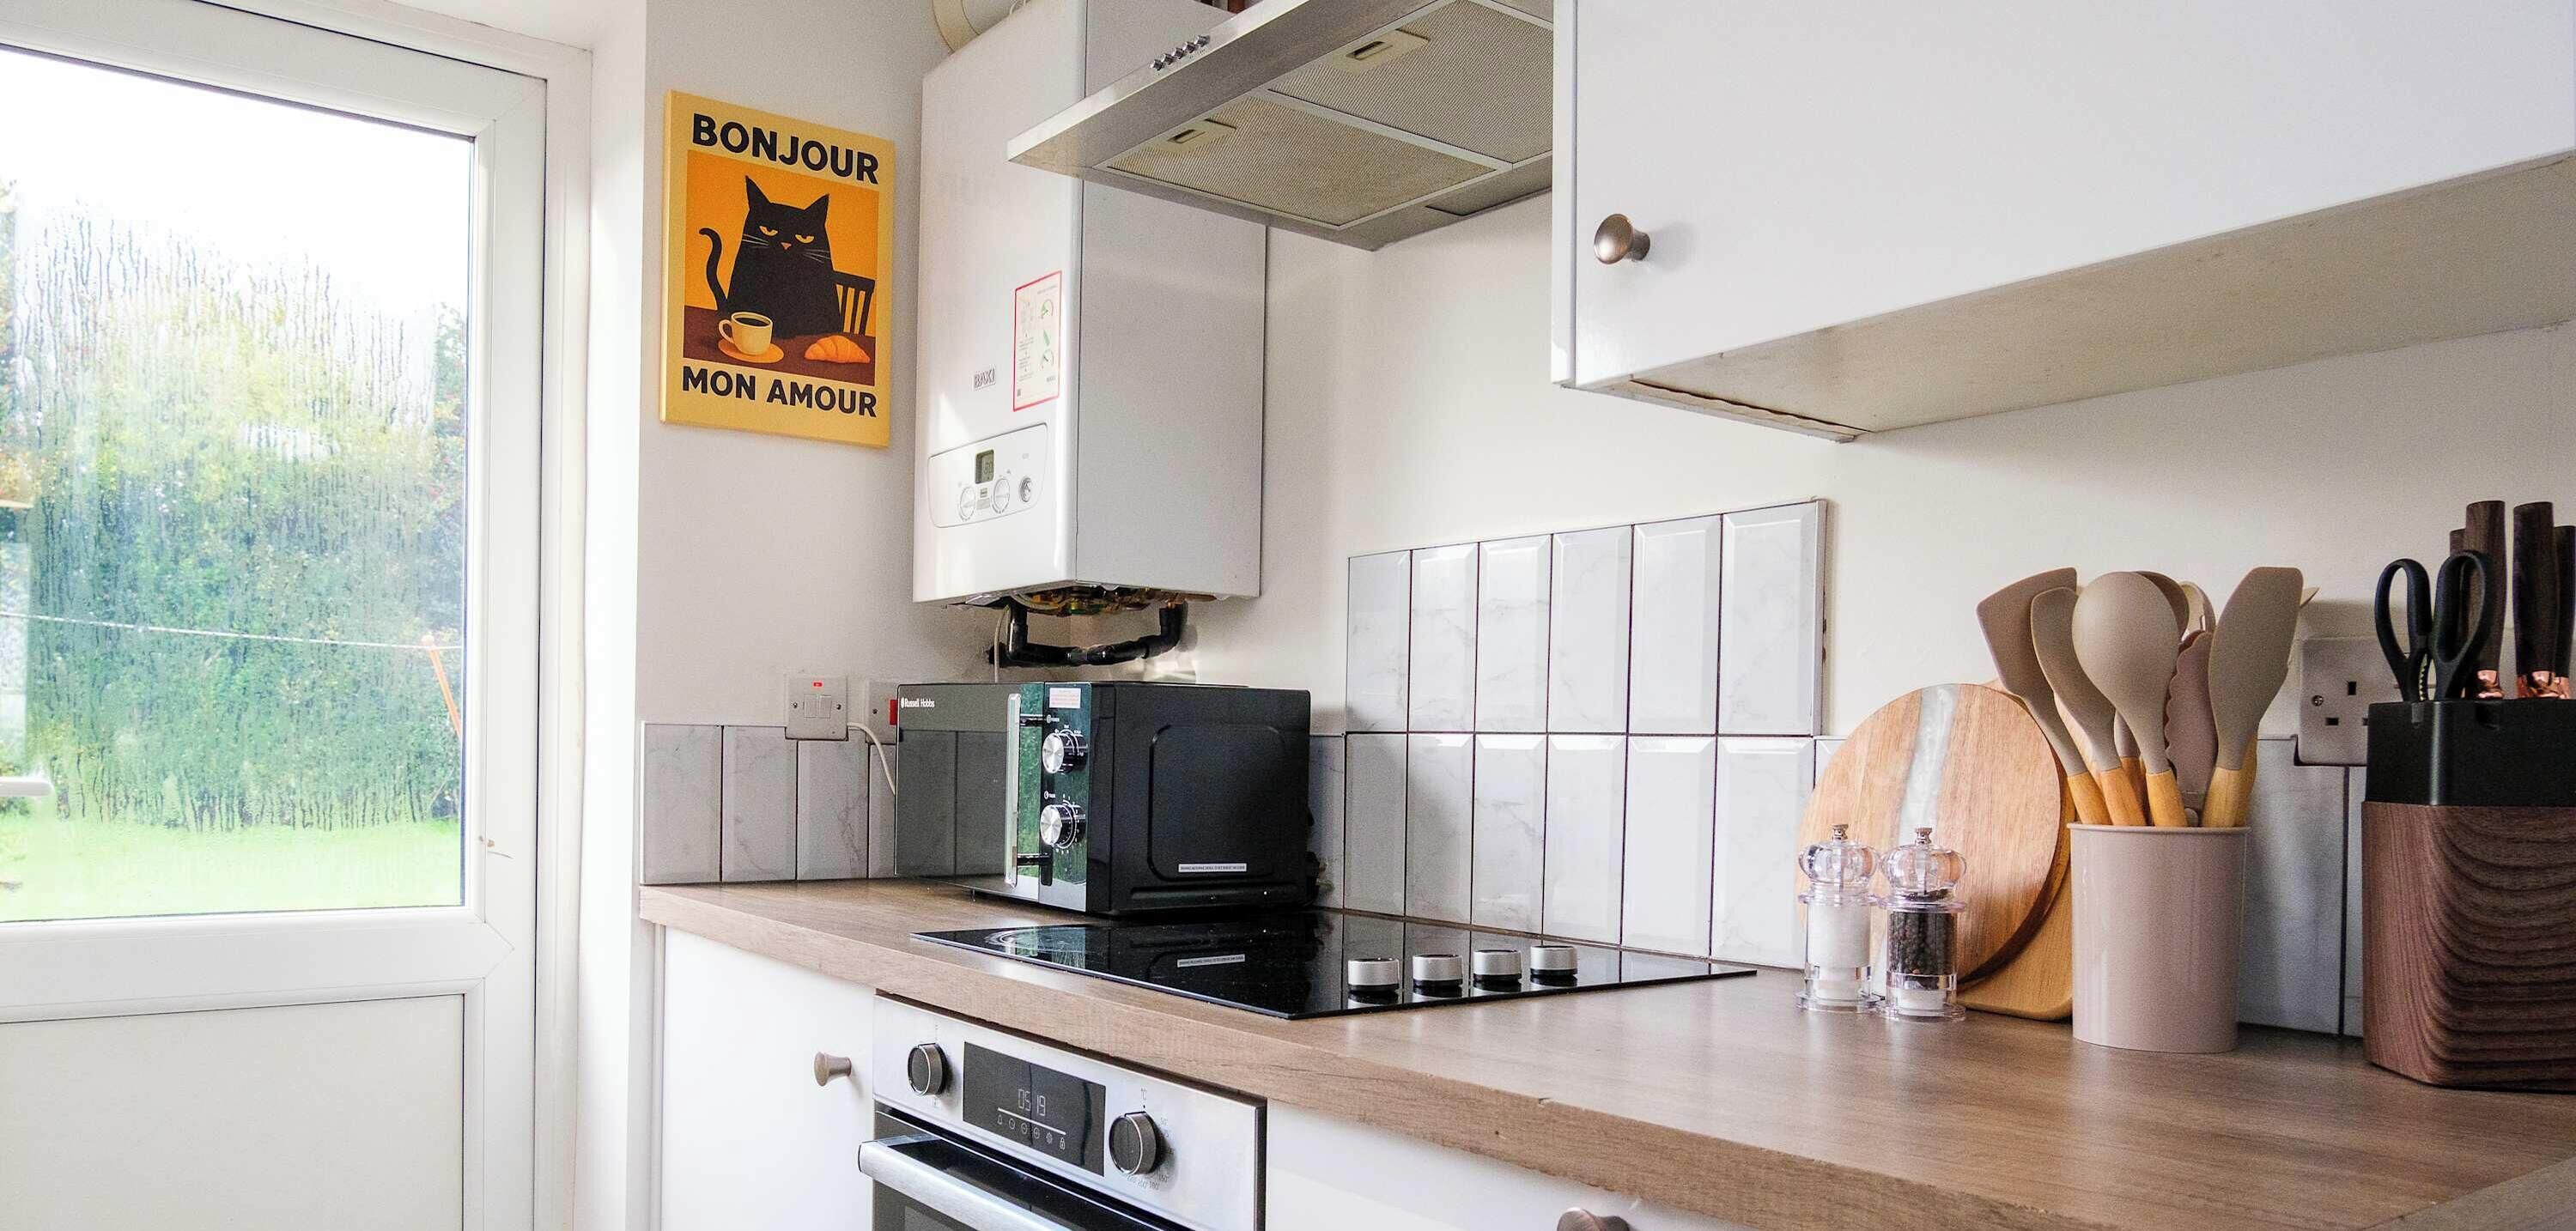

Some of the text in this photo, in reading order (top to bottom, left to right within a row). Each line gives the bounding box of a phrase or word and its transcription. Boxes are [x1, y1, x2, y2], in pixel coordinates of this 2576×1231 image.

[692, 112, 878, 185] BONJOUR
[683, 366, 877, 417] MON AMOUR
[920, 698, 935, 707] Hobbs
